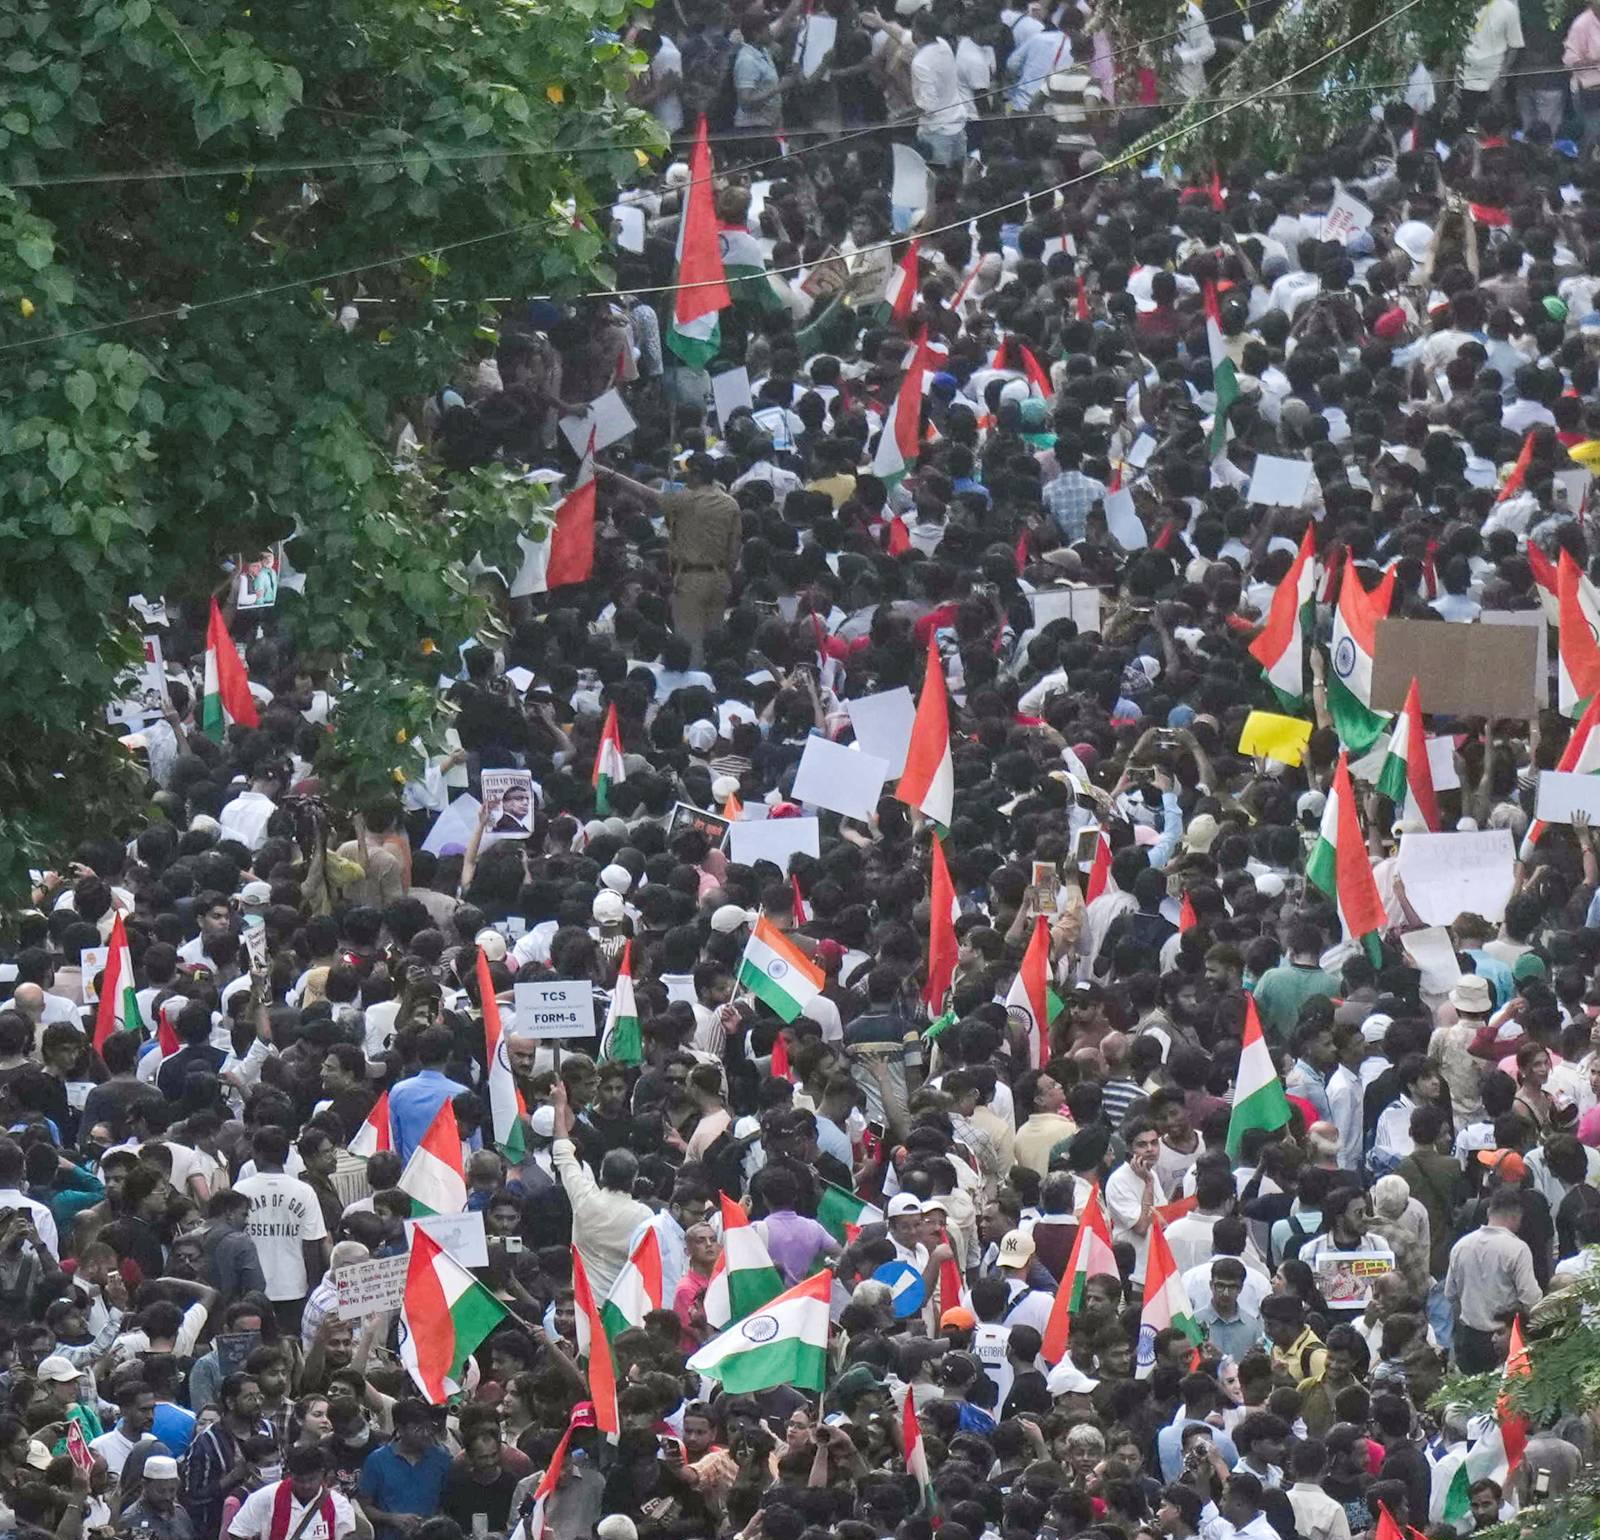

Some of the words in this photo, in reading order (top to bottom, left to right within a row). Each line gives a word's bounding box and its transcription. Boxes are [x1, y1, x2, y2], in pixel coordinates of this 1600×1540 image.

[540, 991, 567, 1001] TCS
[272, 1194, 285, 1207] OF
[288, 1197, 307, 1218] GOD
